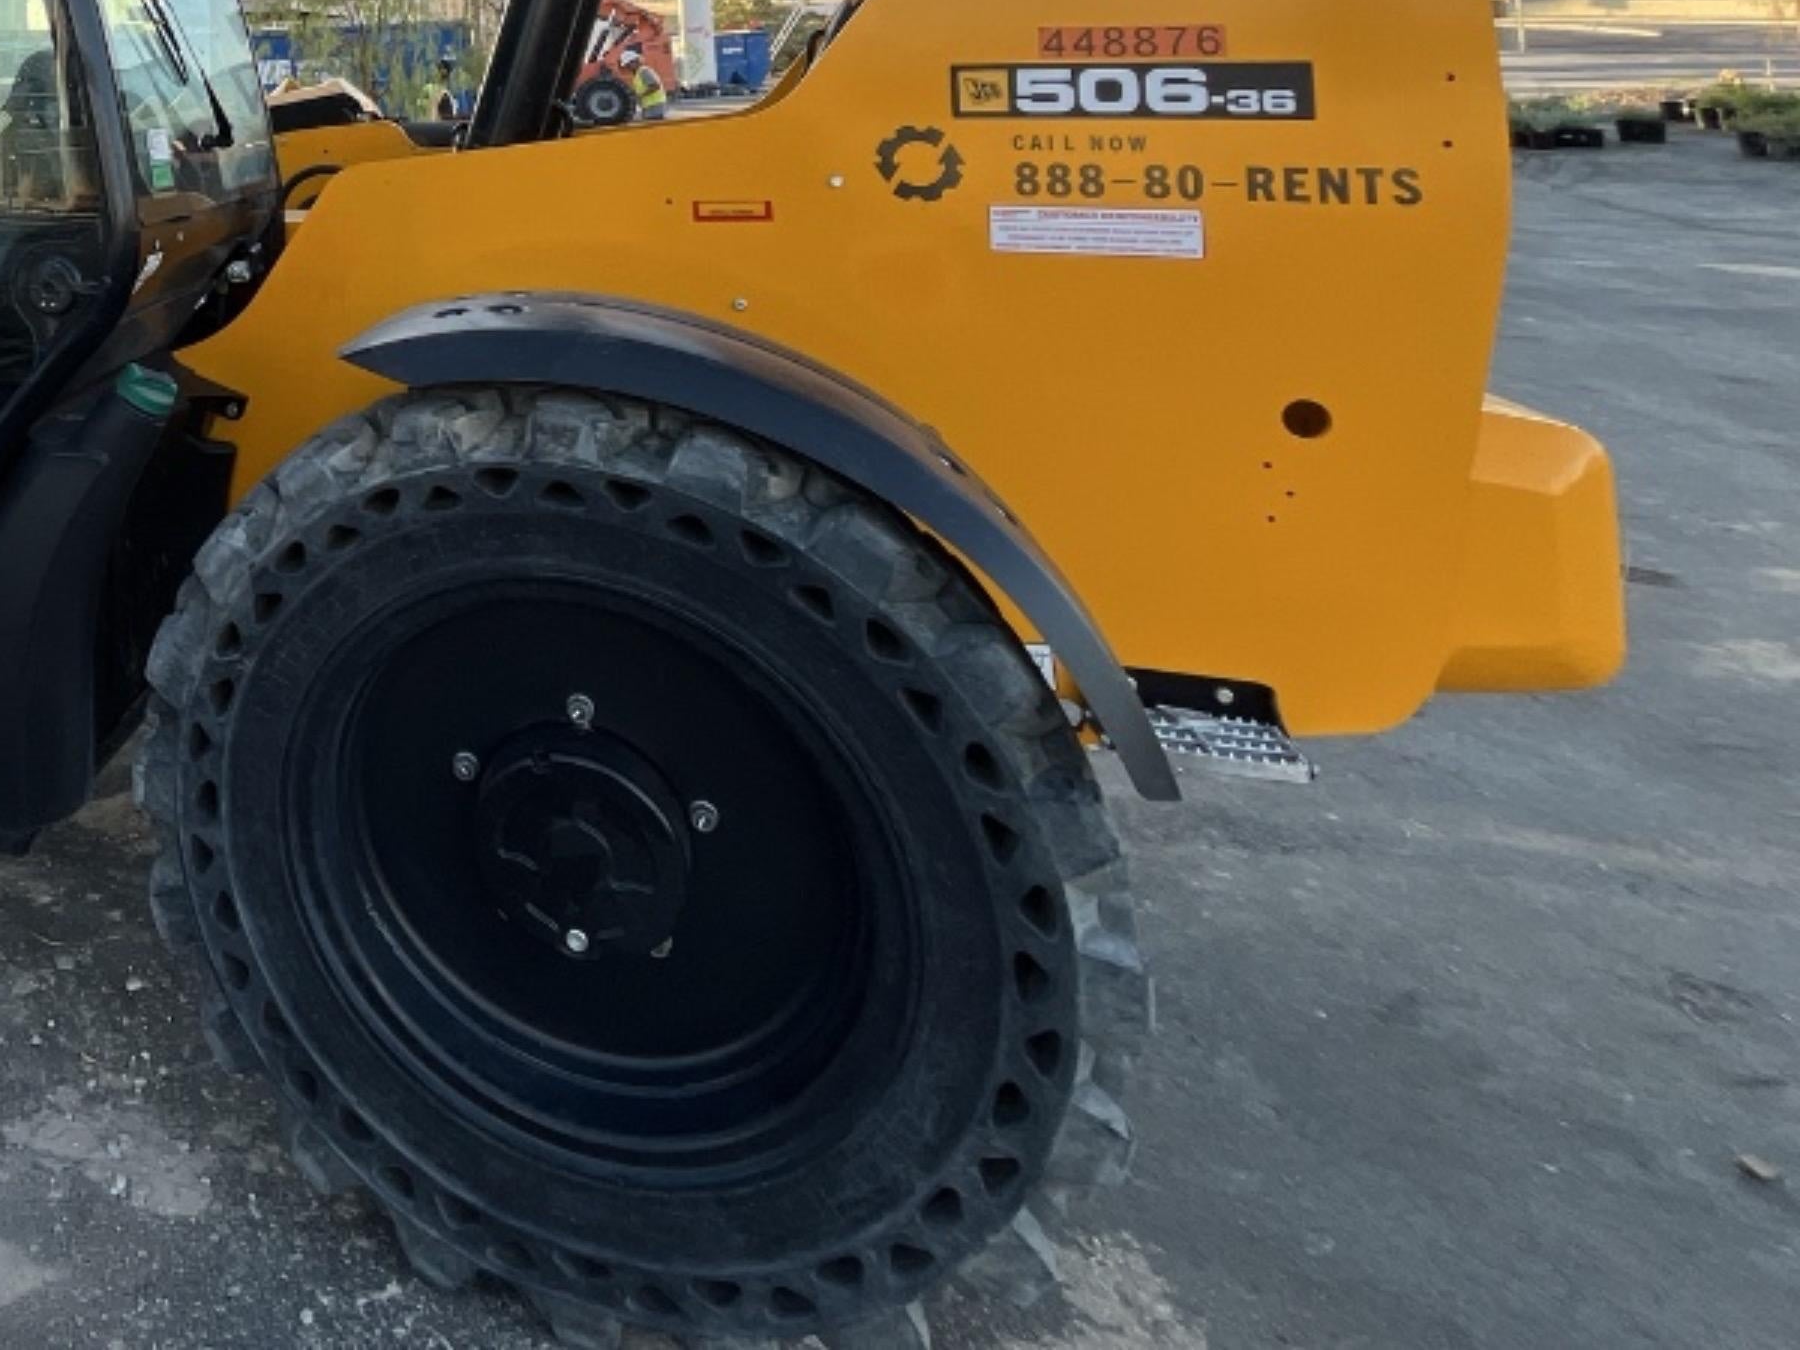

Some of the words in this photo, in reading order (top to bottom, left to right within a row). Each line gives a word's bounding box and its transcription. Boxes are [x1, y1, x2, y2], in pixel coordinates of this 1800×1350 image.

[1042, 26, 1222, 57] 448876
[1015, 67, 1297, 114] 506-36
[1013, 134, 1076, 151] CALL
[1090, 135, 1147, 151] NOW
[1014, 161, 1423, 206] 888-80-RENTS
